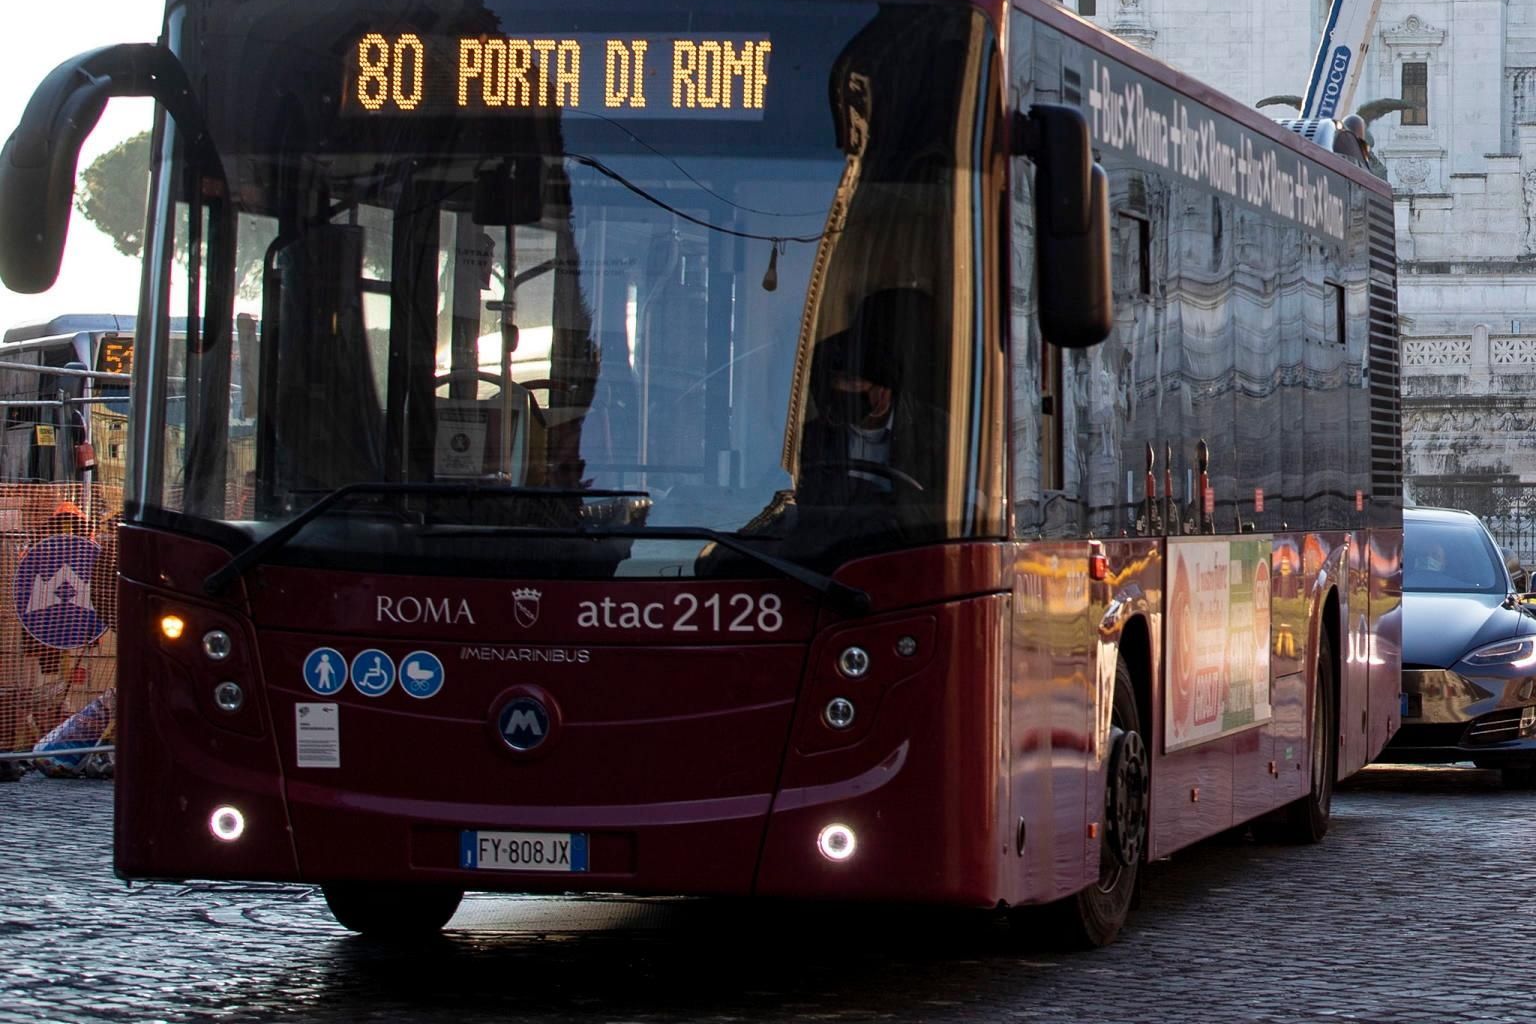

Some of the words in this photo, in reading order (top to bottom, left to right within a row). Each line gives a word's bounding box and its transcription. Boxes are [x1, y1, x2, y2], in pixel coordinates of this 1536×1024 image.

[357, 33, 425, 110] 80
[457, 38, 581, 107] PORTA
[605, 40, 648, 108] DI
[376, 595, 475, 625] ROMA
[577, 599, 664, 629] atac
[672, 593, 783, 632] 2128
[460, 647, 591, 664] MENARINIBUS
